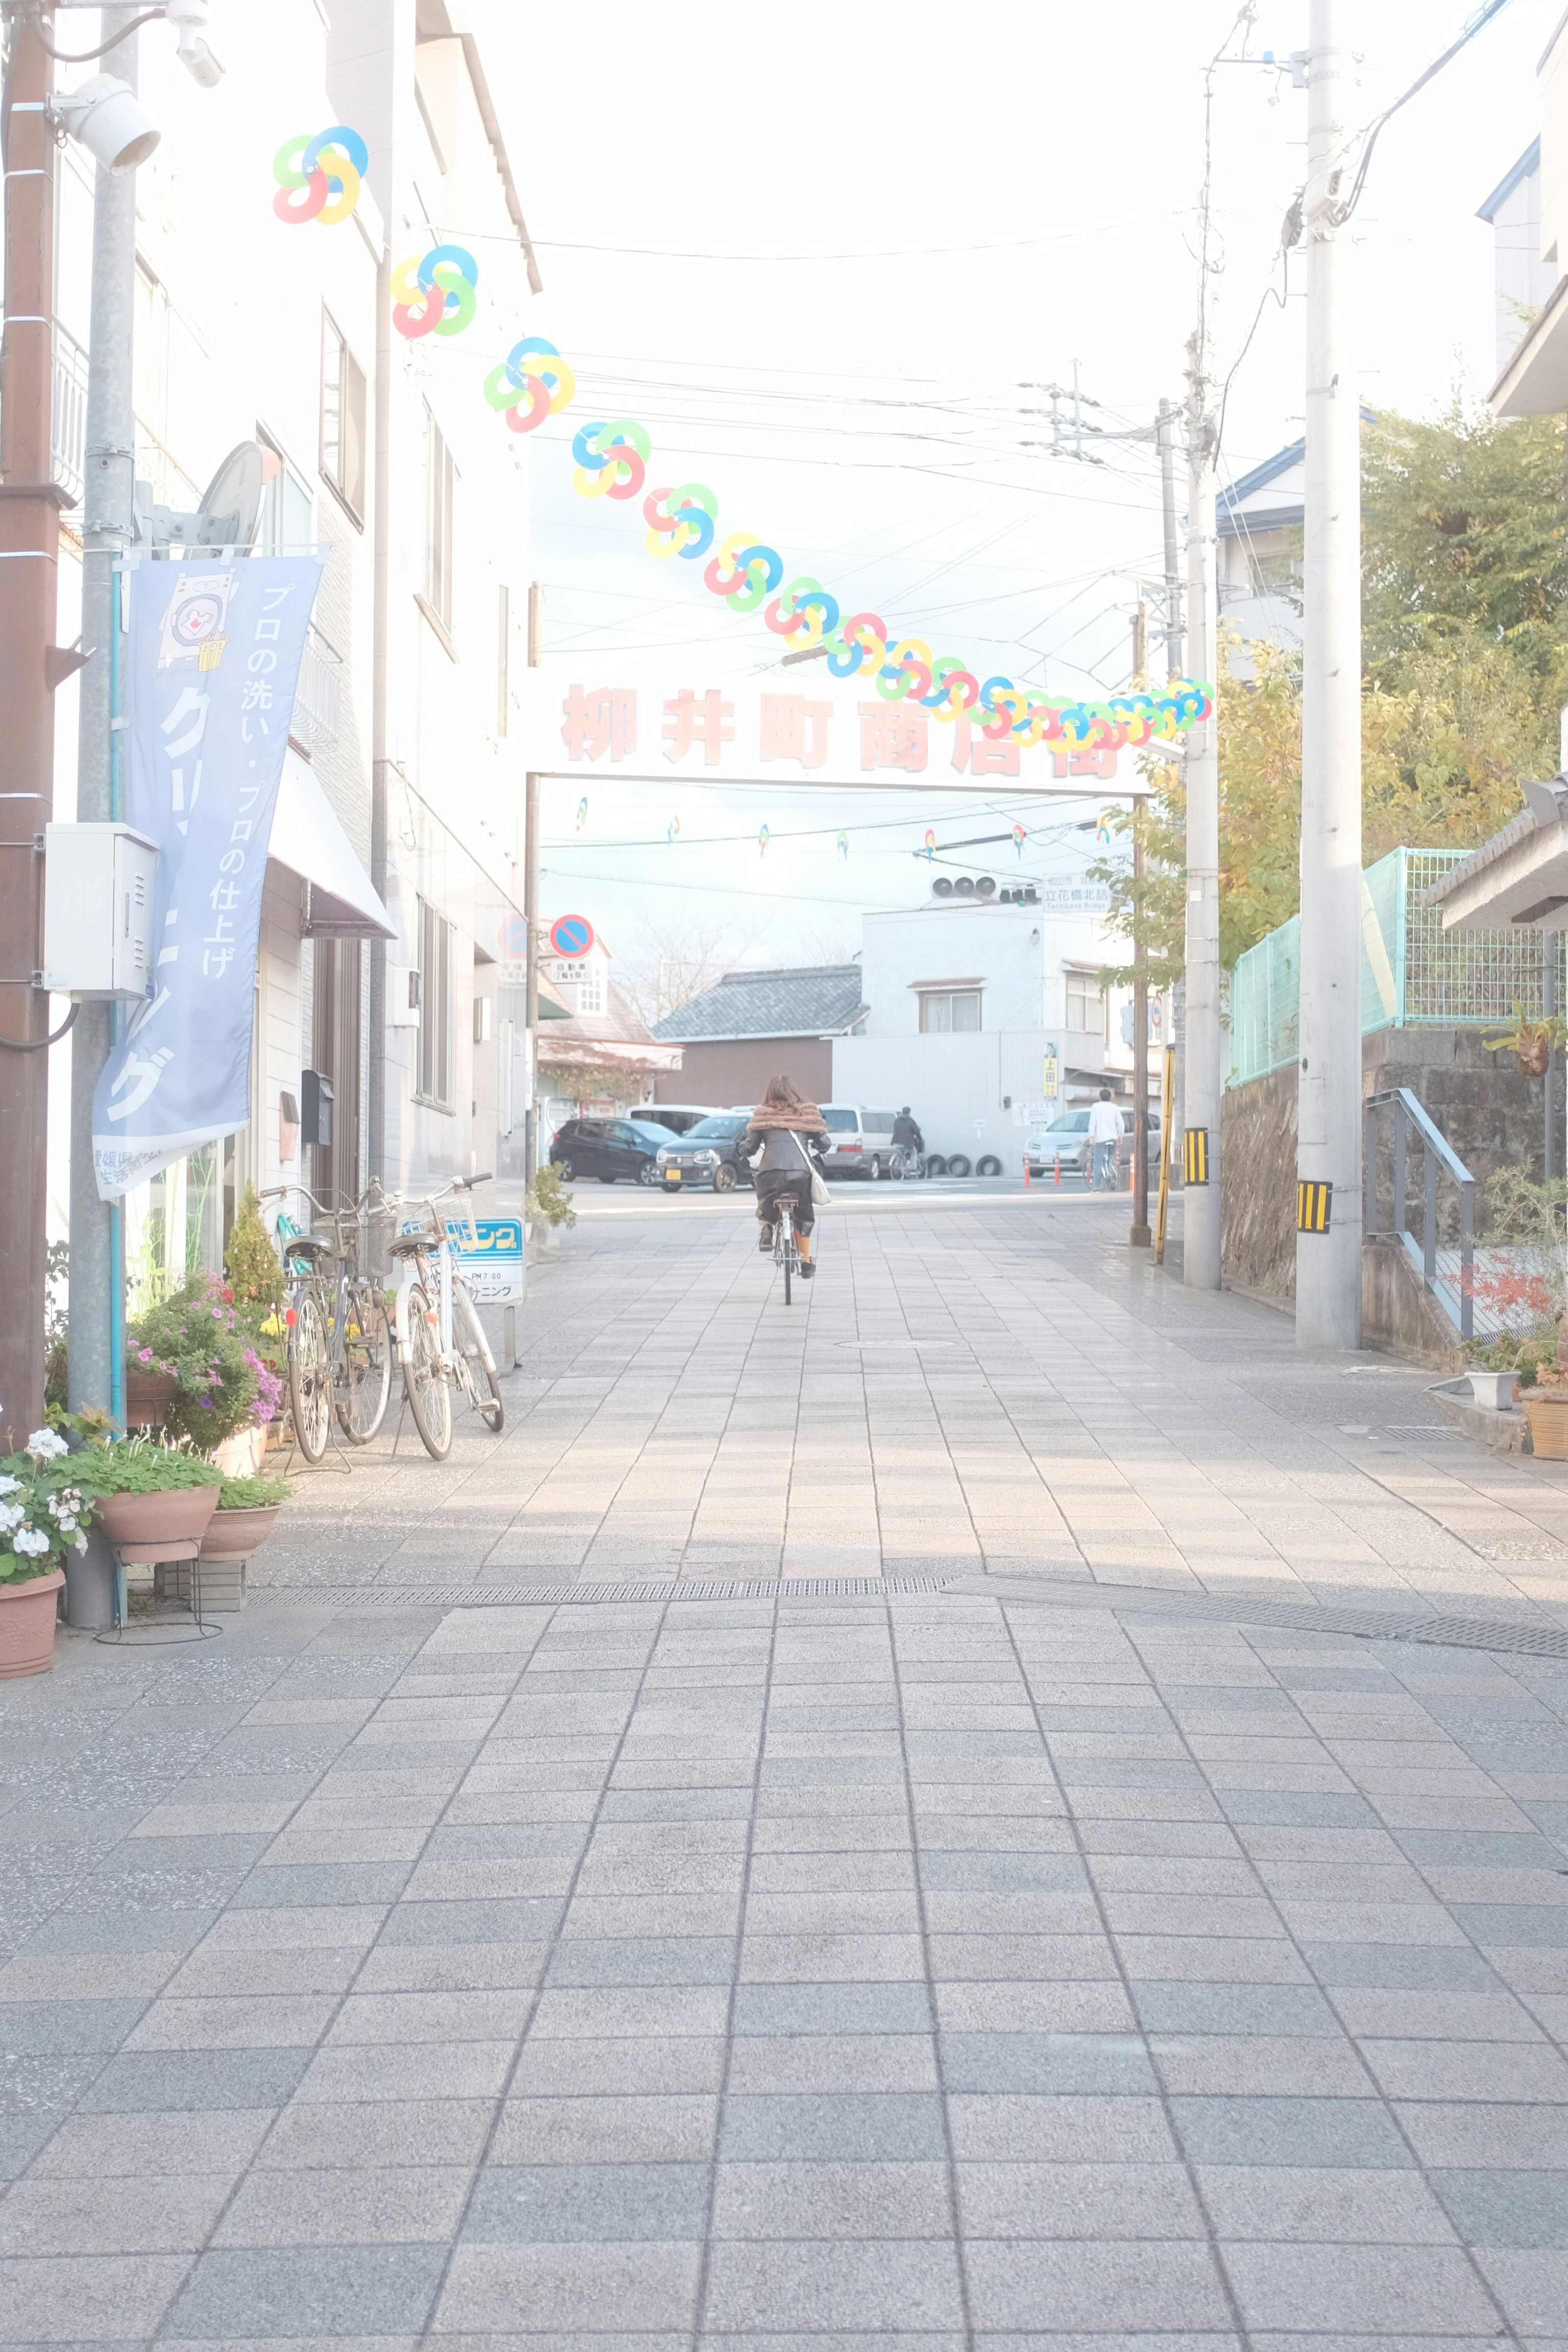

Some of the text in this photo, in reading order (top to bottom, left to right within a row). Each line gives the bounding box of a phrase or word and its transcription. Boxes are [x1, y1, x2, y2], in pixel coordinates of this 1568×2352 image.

[203, 582, 296, 978] プロの洗い・プロの仕上げ
